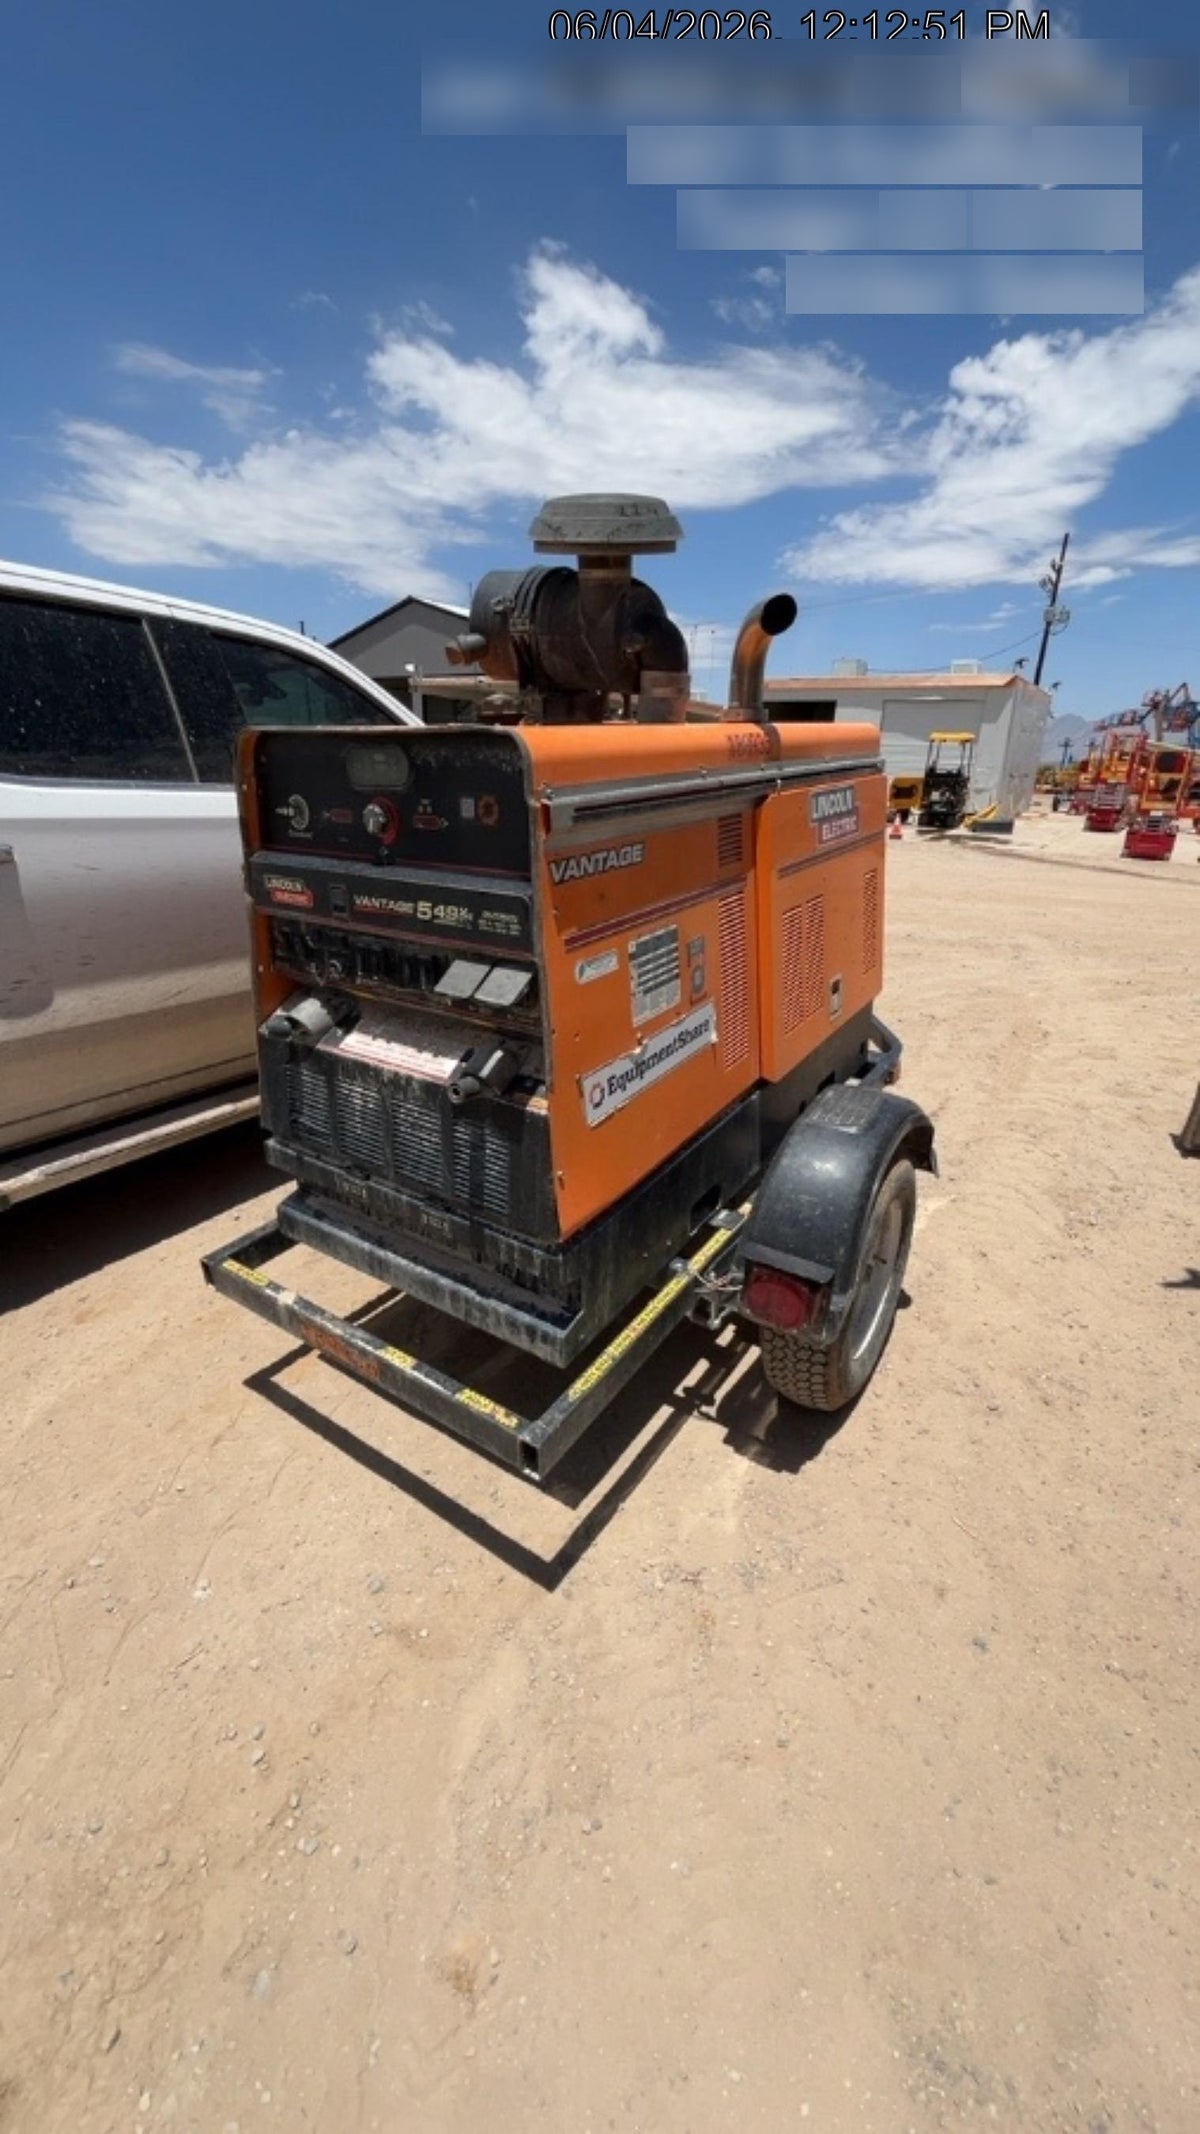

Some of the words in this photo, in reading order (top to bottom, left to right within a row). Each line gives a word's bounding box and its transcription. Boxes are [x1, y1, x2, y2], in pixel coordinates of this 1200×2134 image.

[813, 790, 852, 819] LINCOLN
[822, 816, 857, 840] ELECTRIC
[550, 843, 644, 884] VANTAGE
[353, 895, 415, 914] VANTAGE
[606, 1019, 710, 1096] EquipmentShare
